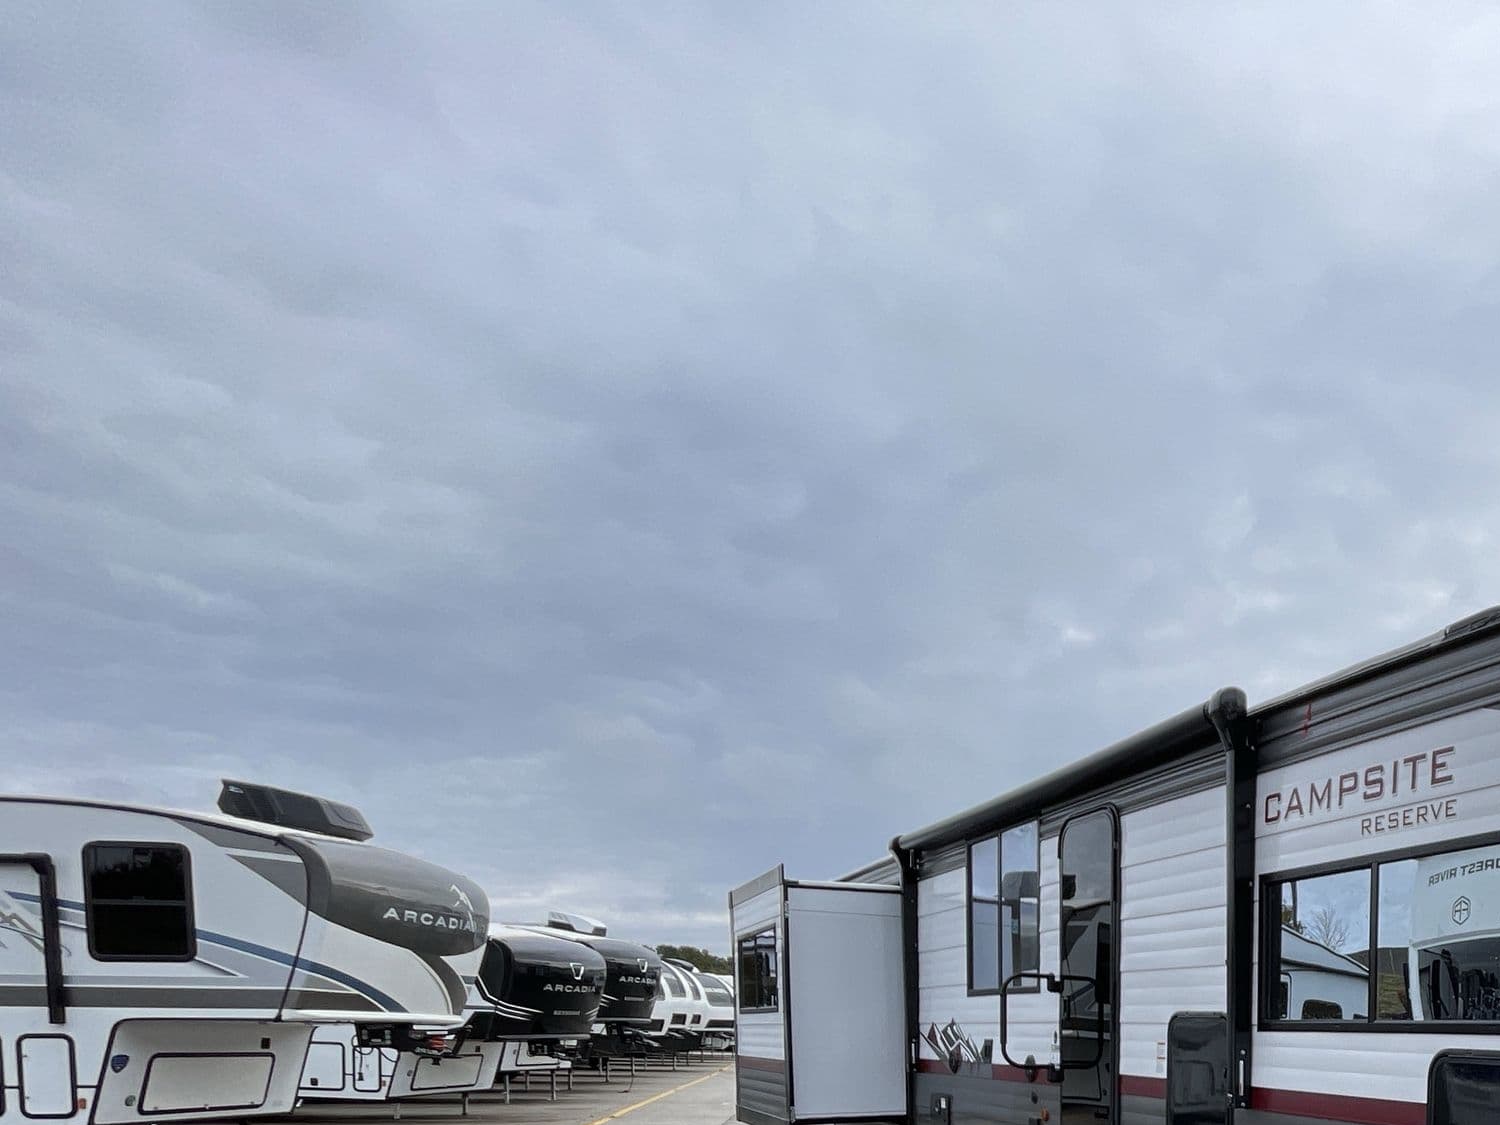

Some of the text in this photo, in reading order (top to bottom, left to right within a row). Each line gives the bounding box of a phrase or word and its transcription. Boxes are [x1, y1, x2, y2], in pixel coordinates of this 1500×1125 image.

[1264, 746, 1455, 824] CAMPSITE
[1361, 799, 1457, 835] RESERVE
[383, 907, 474, 932] ARCADIA
[543, 983, 597, 993] ARCADIA
